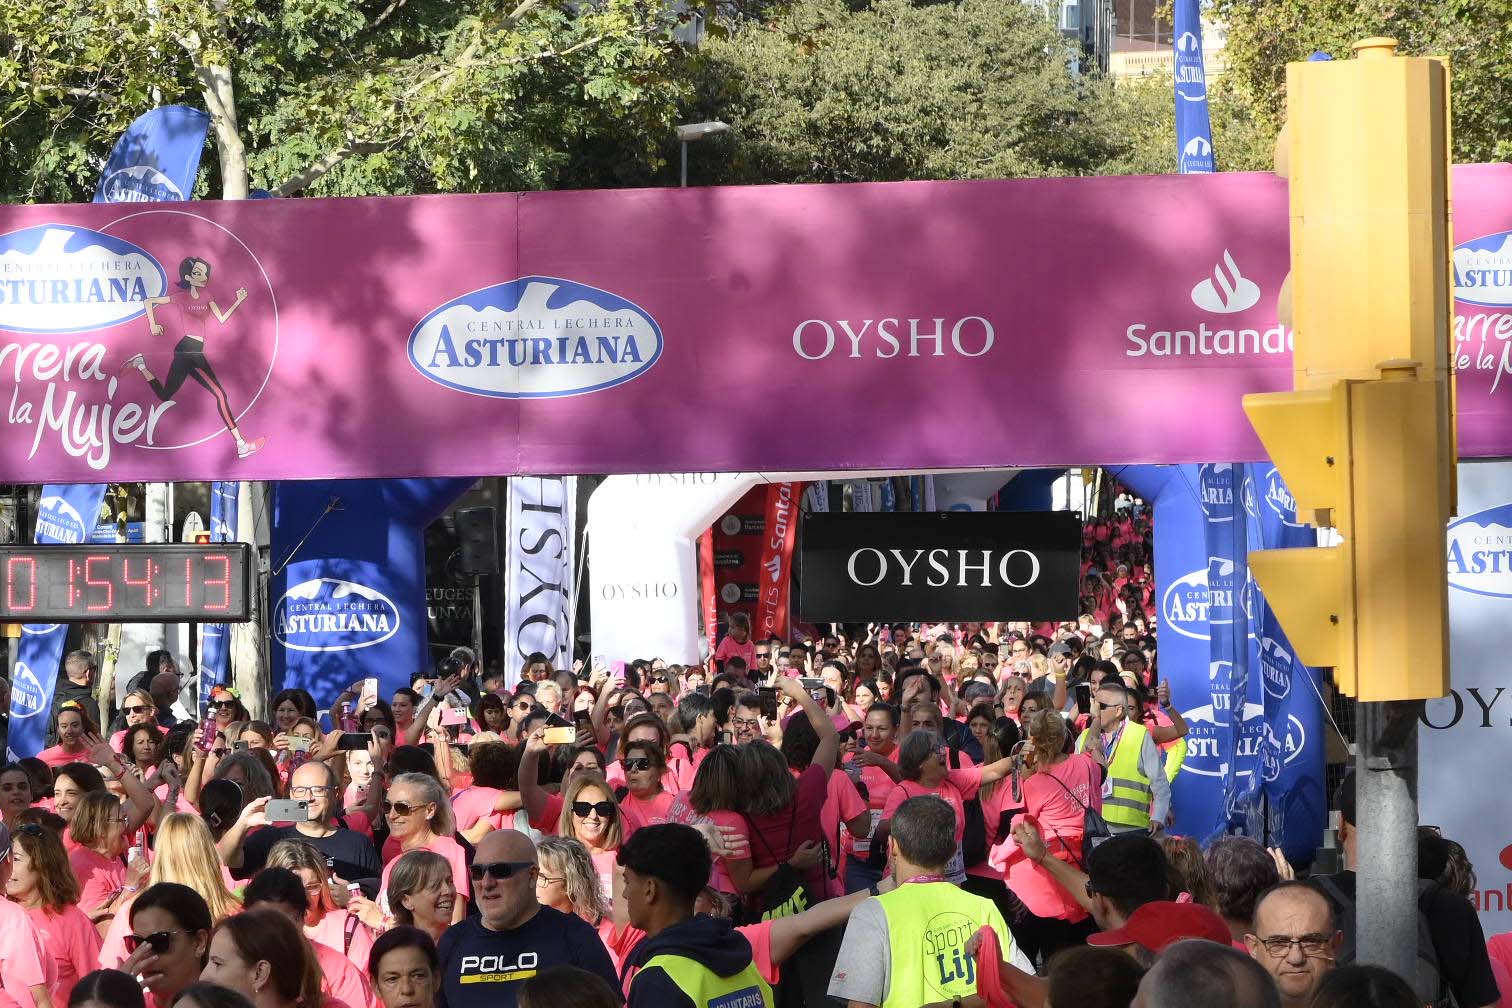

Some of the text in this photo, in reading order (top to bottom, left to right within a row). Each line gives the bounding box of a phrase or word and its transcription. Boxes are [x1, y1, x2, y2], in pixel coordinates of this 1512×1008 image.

[466, 315, 635, 332] CENTRAL LECHERA
[792, 315, 995, 361] OYSHO
[428, 324, 642, 369] ASTURIANA
[8, 382, 33, 424] la
[28, 375, 177, 470] Mujer
[8, 555, 229, 611] 01:54:13
[847, 547, 1040, 588] OYSHO
[290, 601, 386, 611] CENTRAL LECHERA
[602, 581, 677, 600] OYSHO
[278, 608, 390, 635] ASTURIANA
[925, 919, 973, 956] Sport
[460, 951, 538, 974] POLO
[479, 972, 514, 982] SPORT
